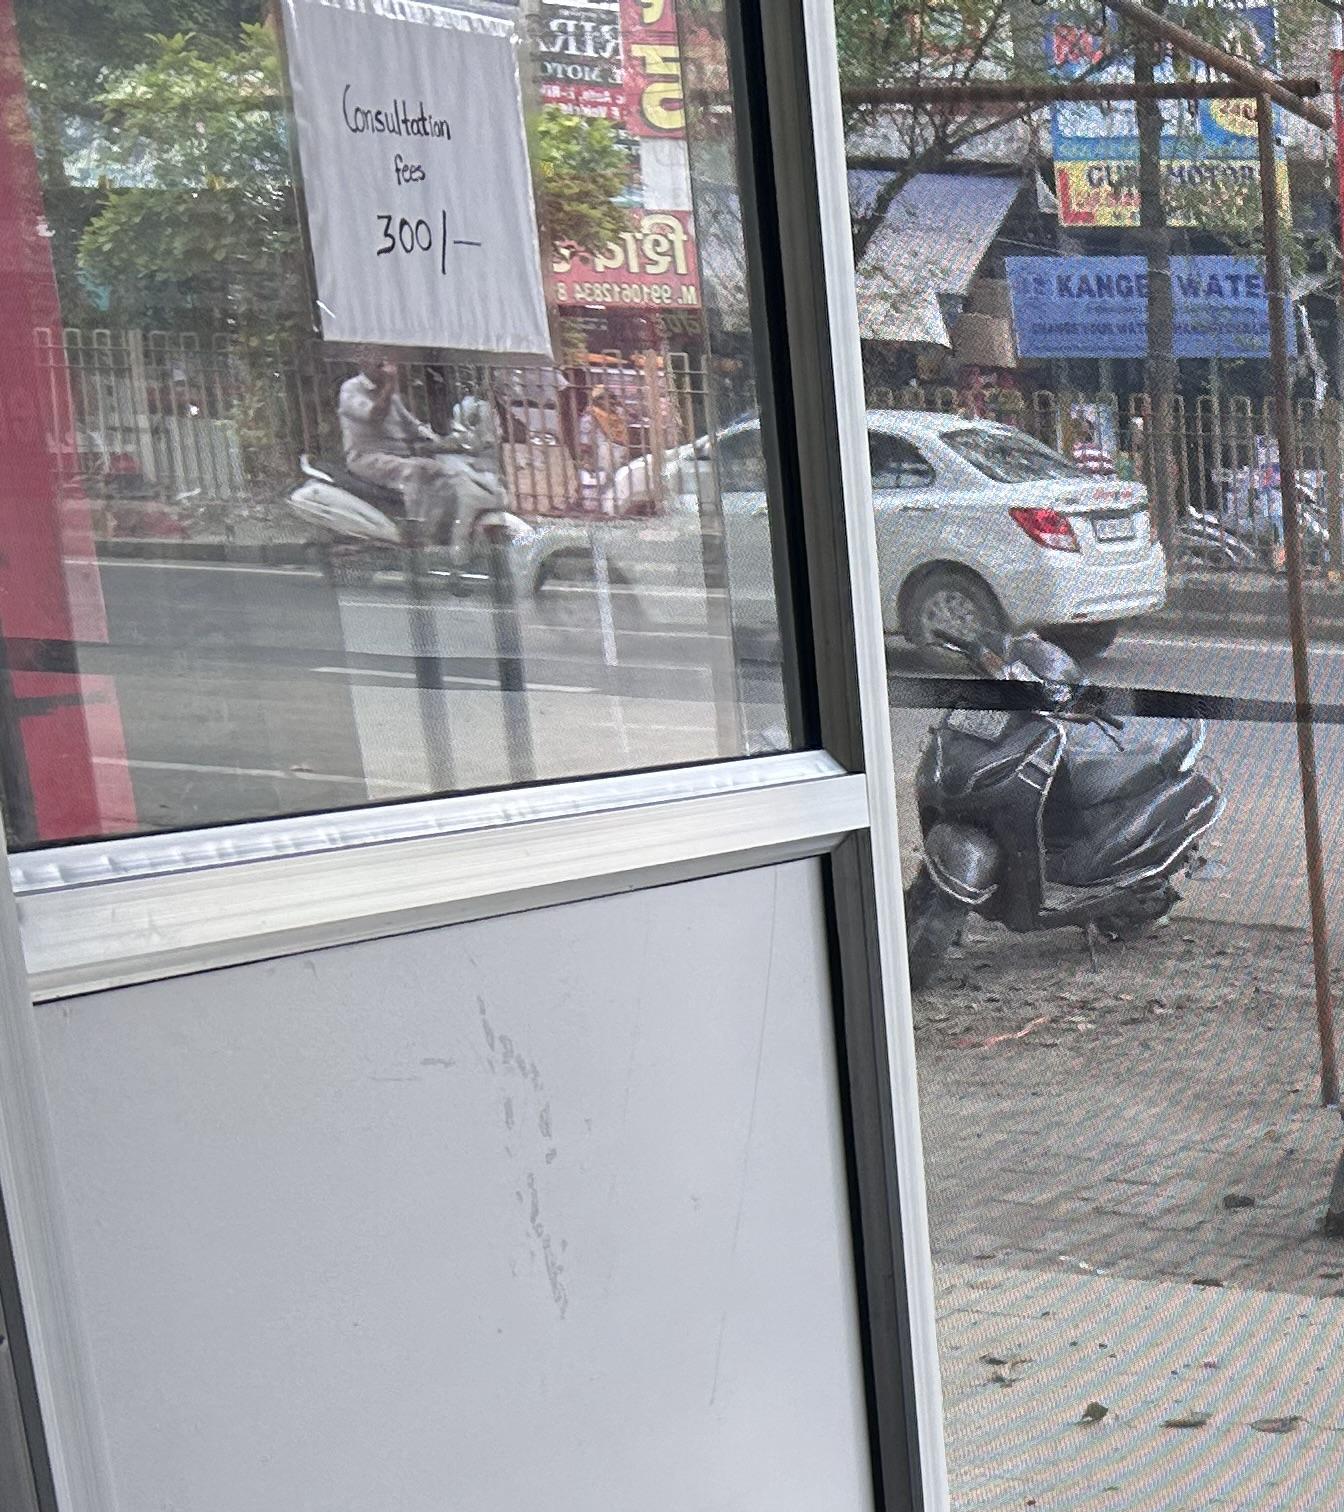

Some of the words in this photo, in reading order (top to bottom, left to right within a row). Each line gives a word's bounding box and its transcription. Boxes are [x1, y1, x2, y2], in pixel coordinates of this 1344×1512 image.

[343, 84, 451, 140] Consultation
[394, 153, 426, 185] fees
[376, 209, 482, 276] 300/-
[1056, 273, 1149, 299] KANGE
[1176, 273, 1269, 299] WATE
